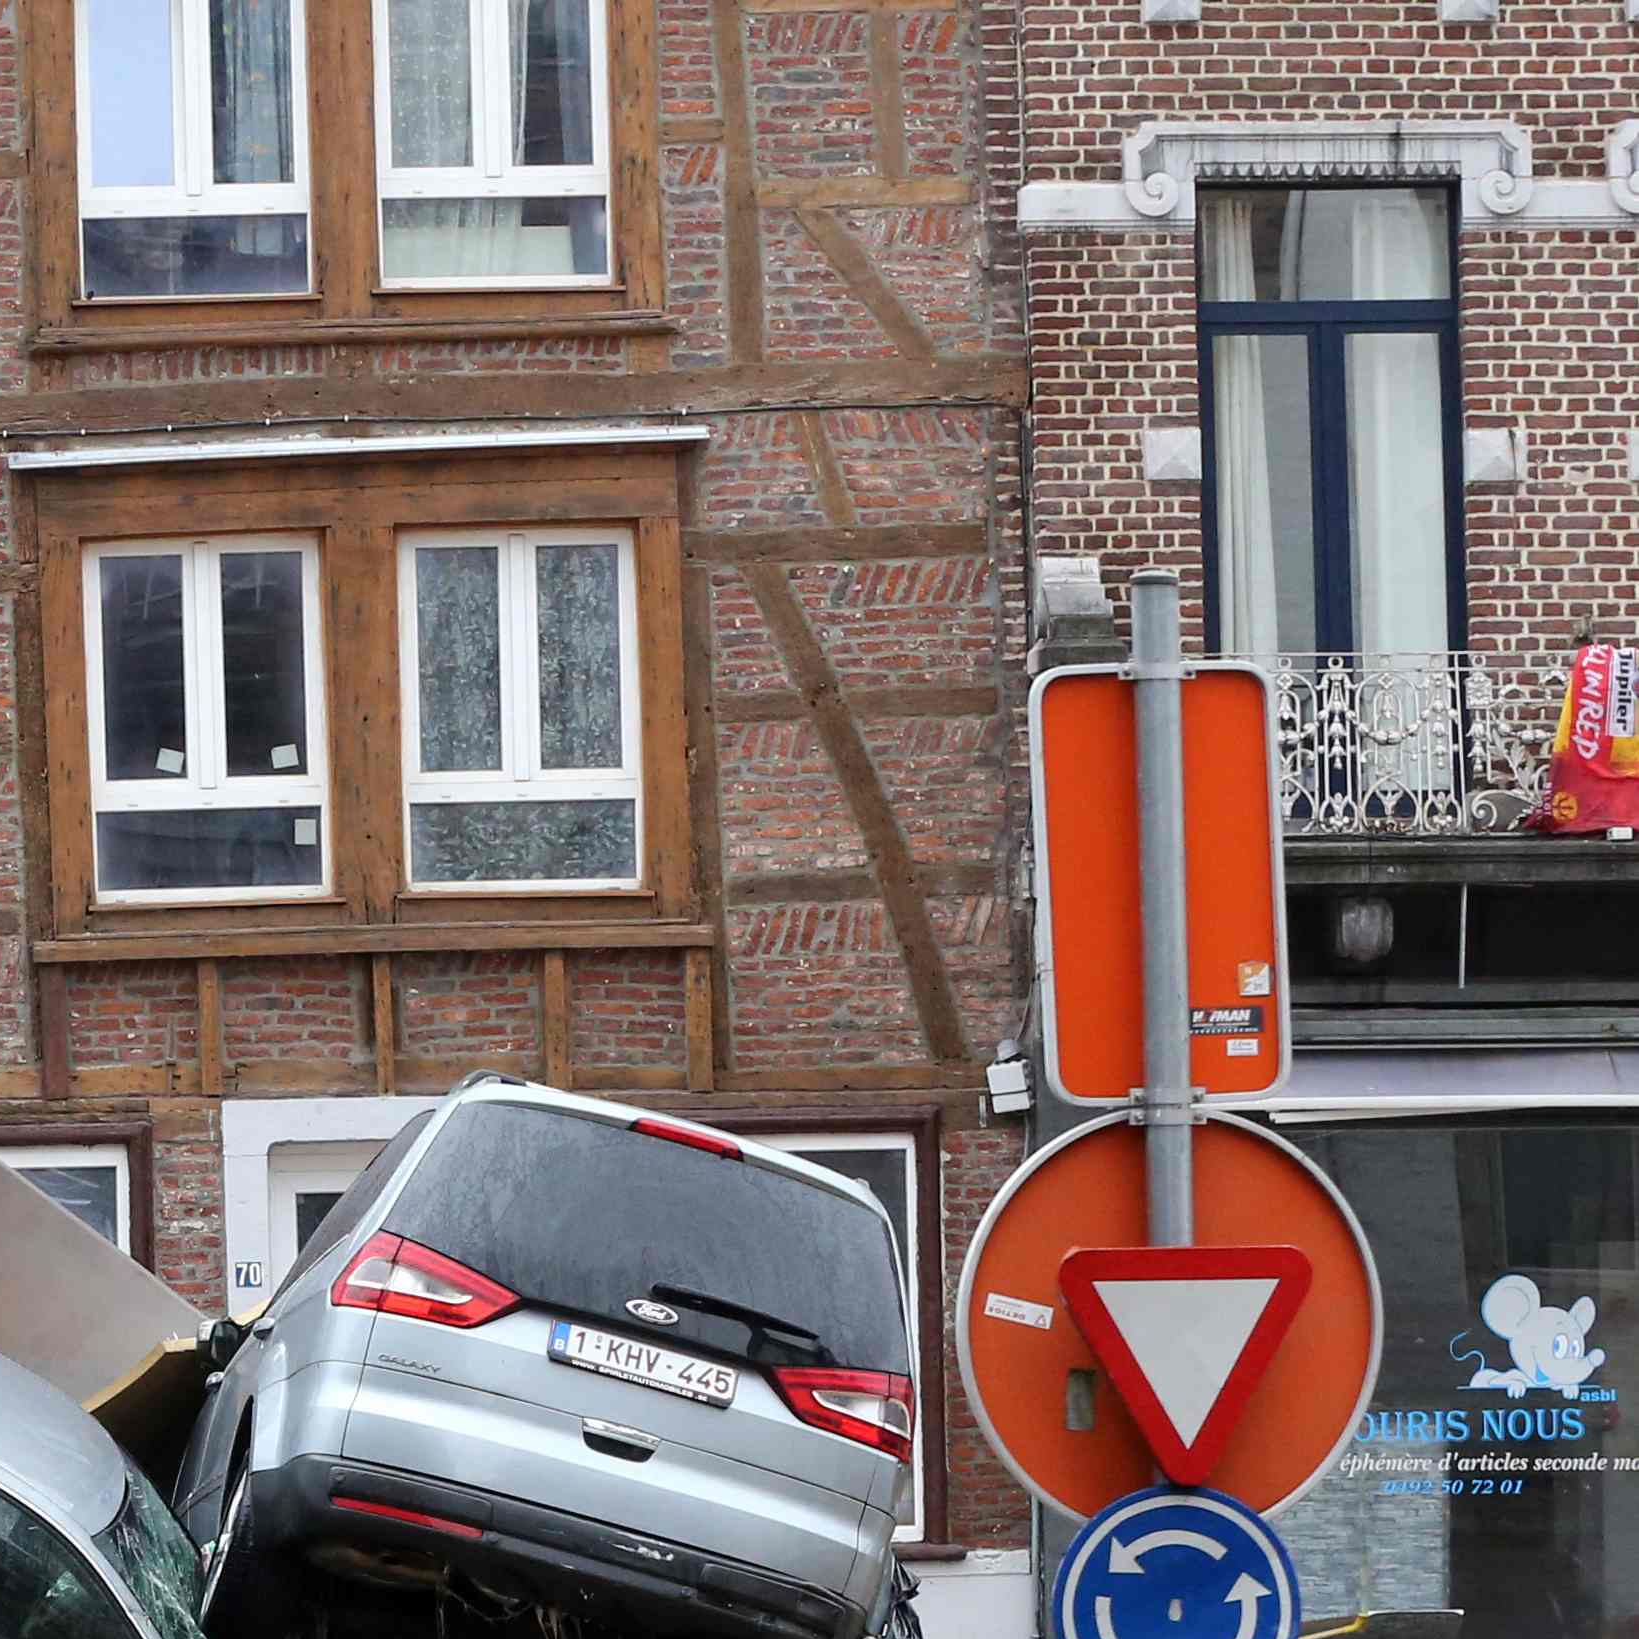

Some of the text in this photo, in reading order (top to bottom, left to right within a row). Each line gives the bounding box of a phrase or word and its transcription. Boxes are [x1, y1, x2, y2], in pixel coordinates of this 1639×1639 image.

[1615, 650, 1633, 733] Jupiler
[236, 1263, 261, 1287] 70
[639, 1301, 668, 1321] Ford
[554, 1338, 565, 1350] B
[1580, 1389, 1617, 1402] asbl
[1353, 1407, 1587, 1442] OURIS NOUS
[1339, 1453, 1433, 1478] éphémère
[1438, 1451, 1529, 1472] d'articles
[1532, 1452, 1607, 1472] seconde
[1442, 1479, 1464, 1495] 50
[1472, 1479, 1494, 1494] 72
